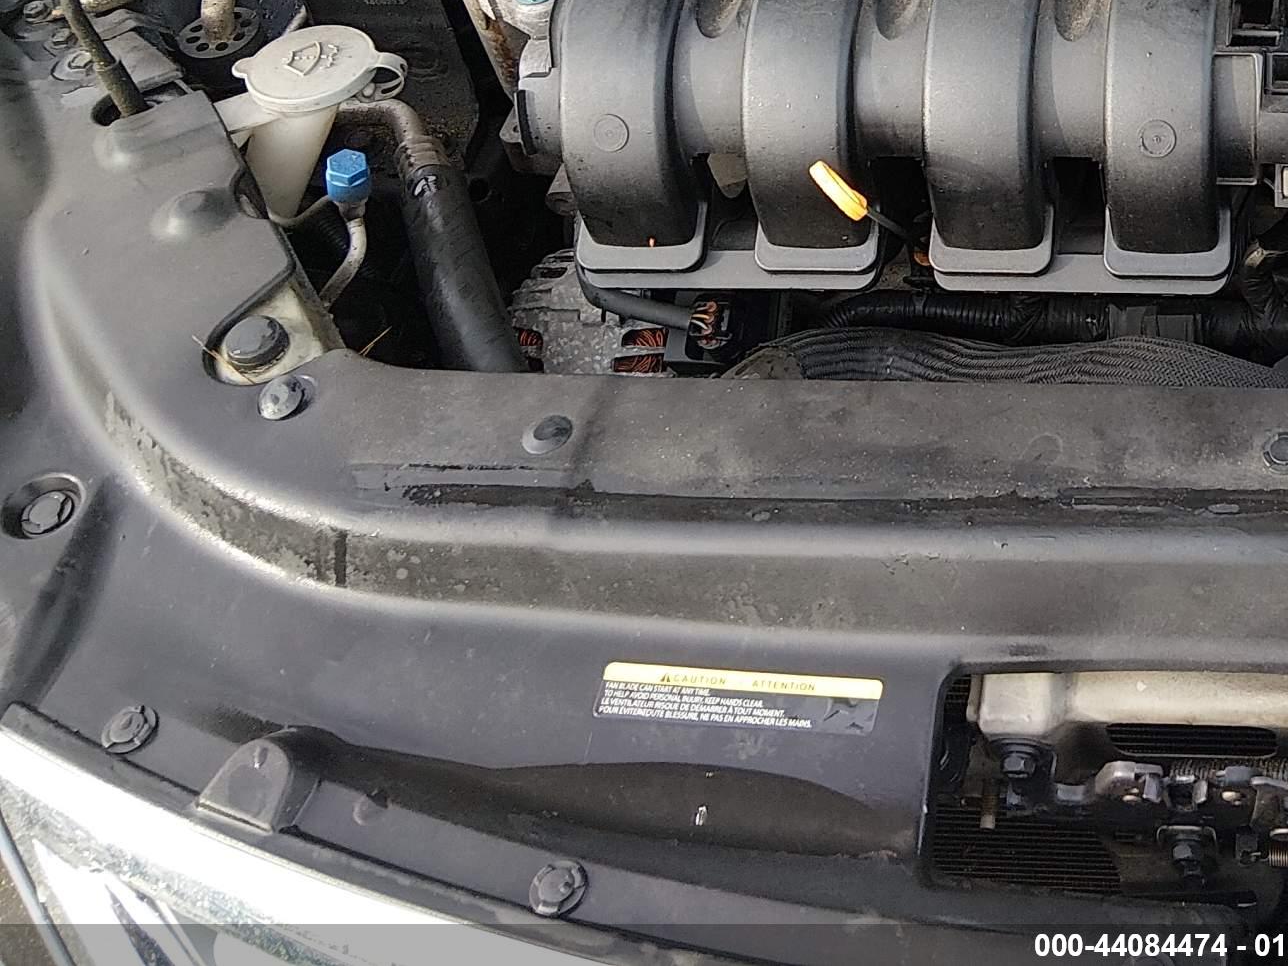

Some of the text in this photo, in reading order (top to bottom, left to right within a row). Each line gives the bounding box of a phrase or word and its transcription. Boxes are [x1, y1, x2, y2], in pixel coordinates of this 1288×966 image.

[606, 681, 618, 689] FAN
[619, 682, 638, 691] BLADE
[639, 683, 653, 692] CAN
[672, 686, 681, 694] AT
[681, 687, 695, 695] ANY
[673, 675, 815, 690] CAUTION ATTENTION
[601, 697, 609, 705] LE
[610, 698, 655, 708] VENTILATEUR
[655, 701, 680, 710] RISQUE
[680, 703, 690, 711] DE
[734, 707, 752, 716] TOUT
[604, 689, 613, 697] TO
[613, 690, 629, 698] HELP
[629, 691, 649, 700] AVOID
[650, 693, 681, 702] PERSONAL
[705, 696, 720, 705] KEEP
[720, 698, 743, 707] HANDS
[598, 705, 619, 714] POUR
[699, 712, 710, 721] NE
[710, 713, 723, 722] PAS
[723, 714, 734, 723] EN
[734, 715, 775, 726] APPROCHER
[775, 718, 788, 727] LES
